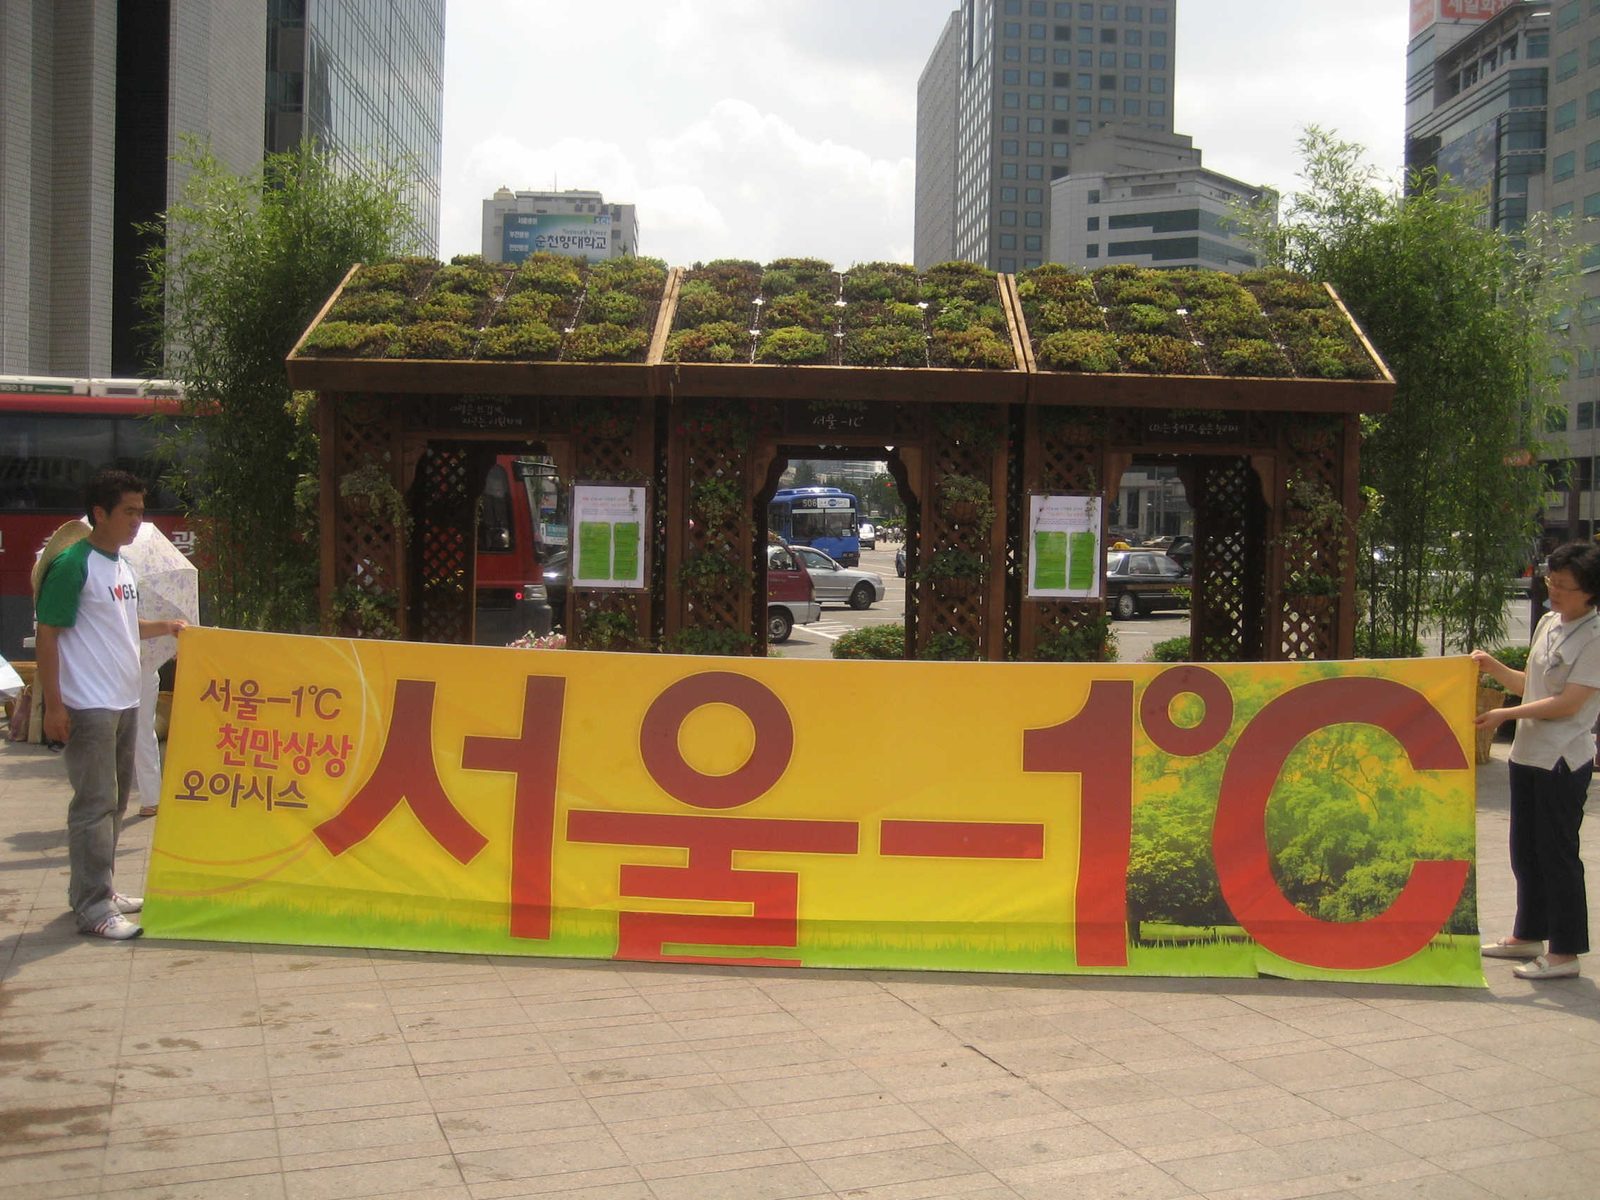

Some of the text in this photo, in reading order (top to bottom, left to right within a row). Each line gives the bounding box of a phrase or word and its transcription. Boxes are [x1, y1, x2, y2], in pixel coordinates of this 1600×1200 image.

[535, 235, 607, 250] 순천향대학교
[216, 723, 353, 778] 천만상상
[174, 770, 309, 811] 오아시스
